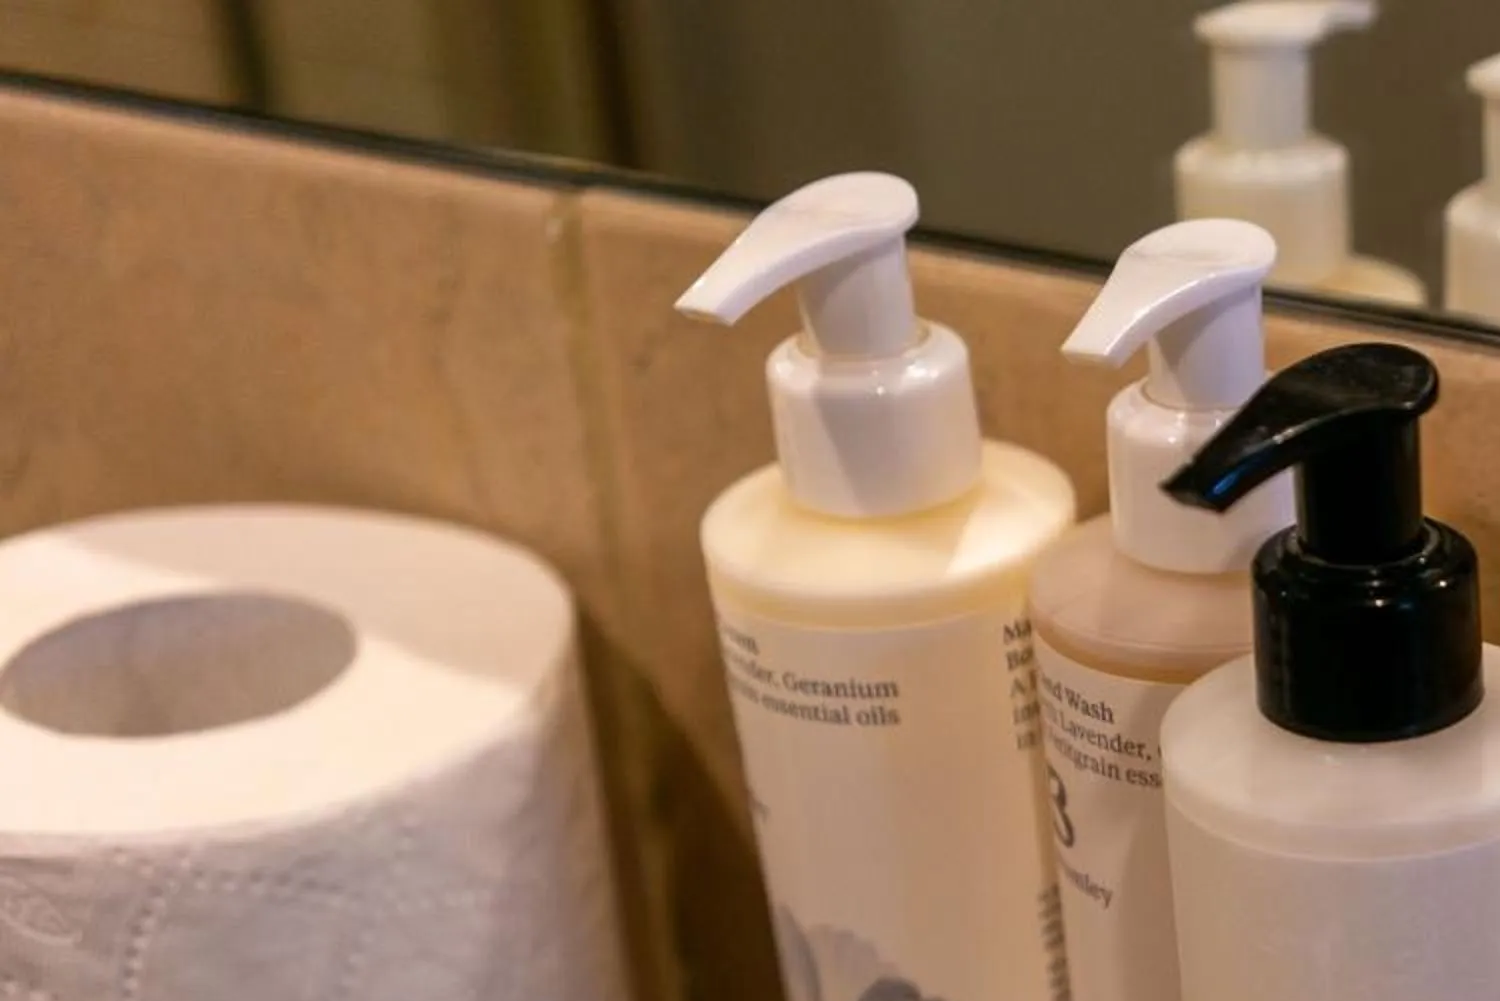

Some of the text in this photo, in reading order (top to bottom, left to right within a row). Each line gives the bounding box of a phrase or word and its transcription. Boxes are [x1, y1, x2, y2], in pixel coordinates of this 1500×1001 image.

[783, 670, 899, 698] Geranium
[761, 693, 900, 727] essential oils
[1064, 687, 1115, 724] Wash
[1059, 710, 1152, 761] Lavender,
